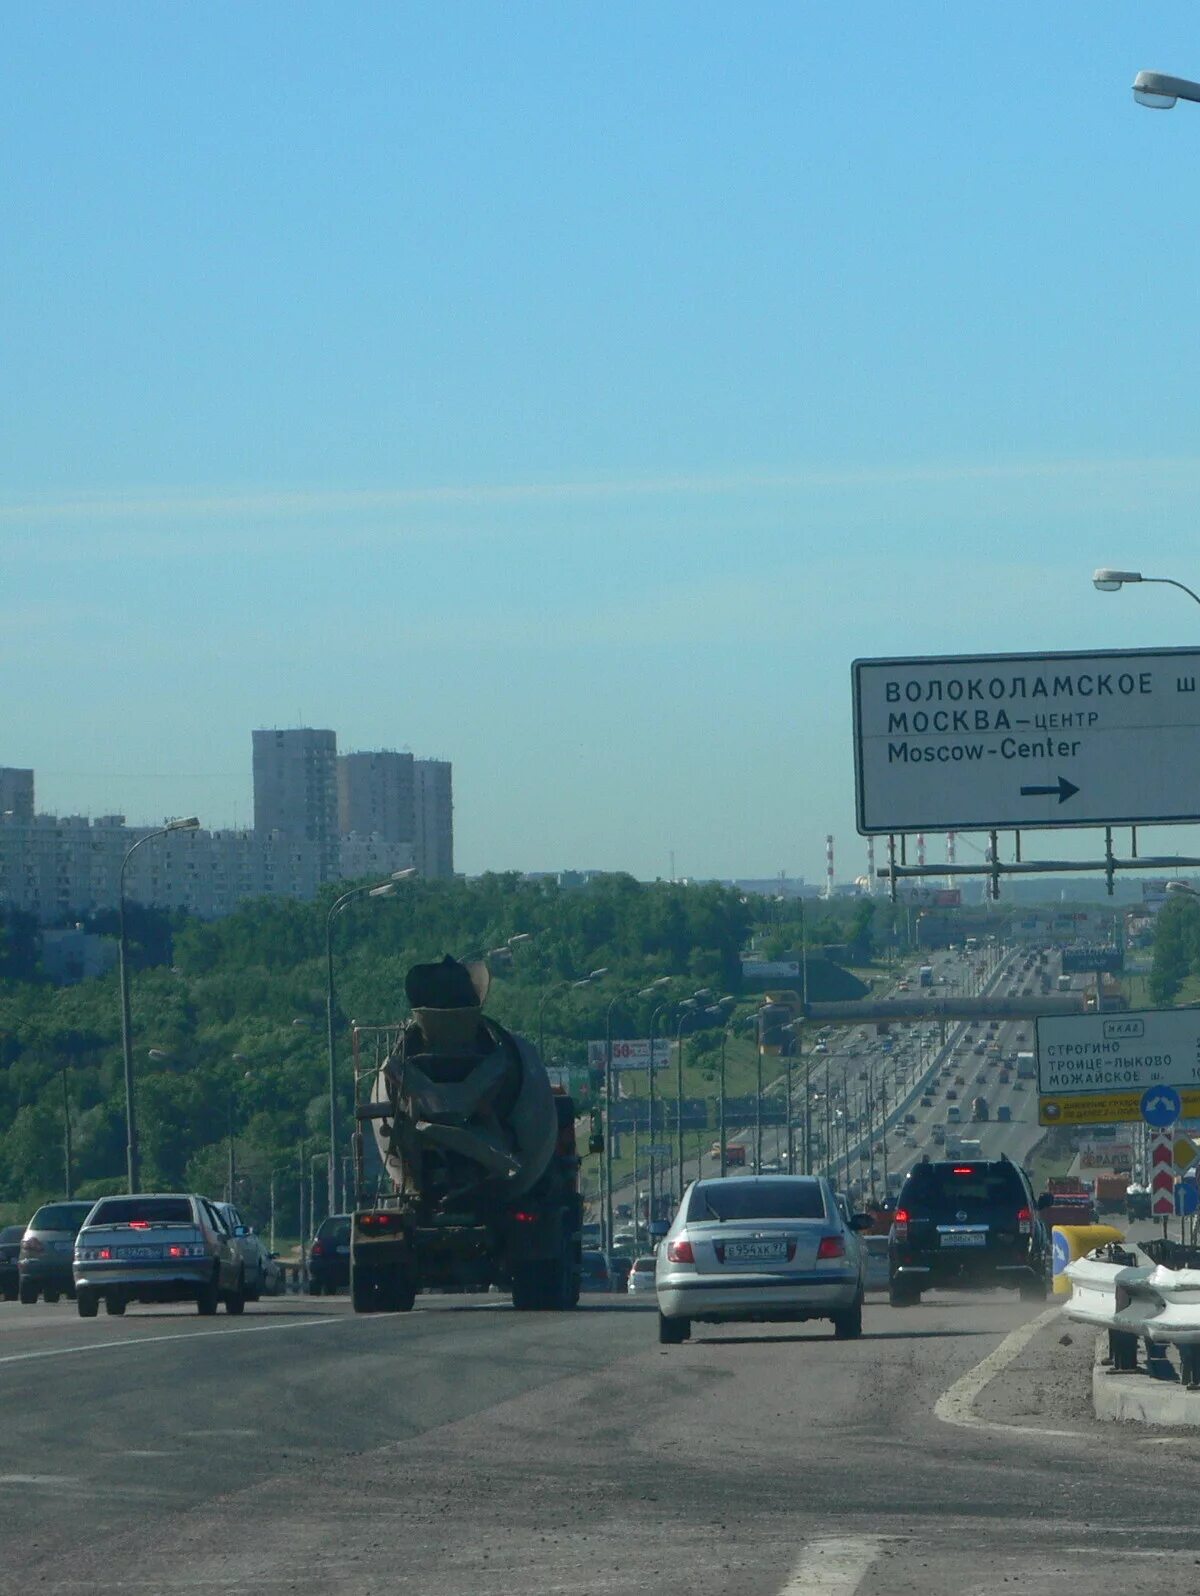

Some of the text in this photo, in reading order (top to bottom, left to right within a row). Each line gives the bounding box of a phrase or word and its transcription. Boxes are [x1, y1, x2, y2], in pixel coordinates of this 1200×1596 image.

[886, 672, 1153, 703] ВОЛОКОЛАМСКОЕ
[888, 739, 1081, 763] Moscow-Center
[1047, 1042, 1121, 1056] СТРОГИНО
[1048, 1054, 1172, 1071] ТРОИЦЕ-ЛЫКОВО
